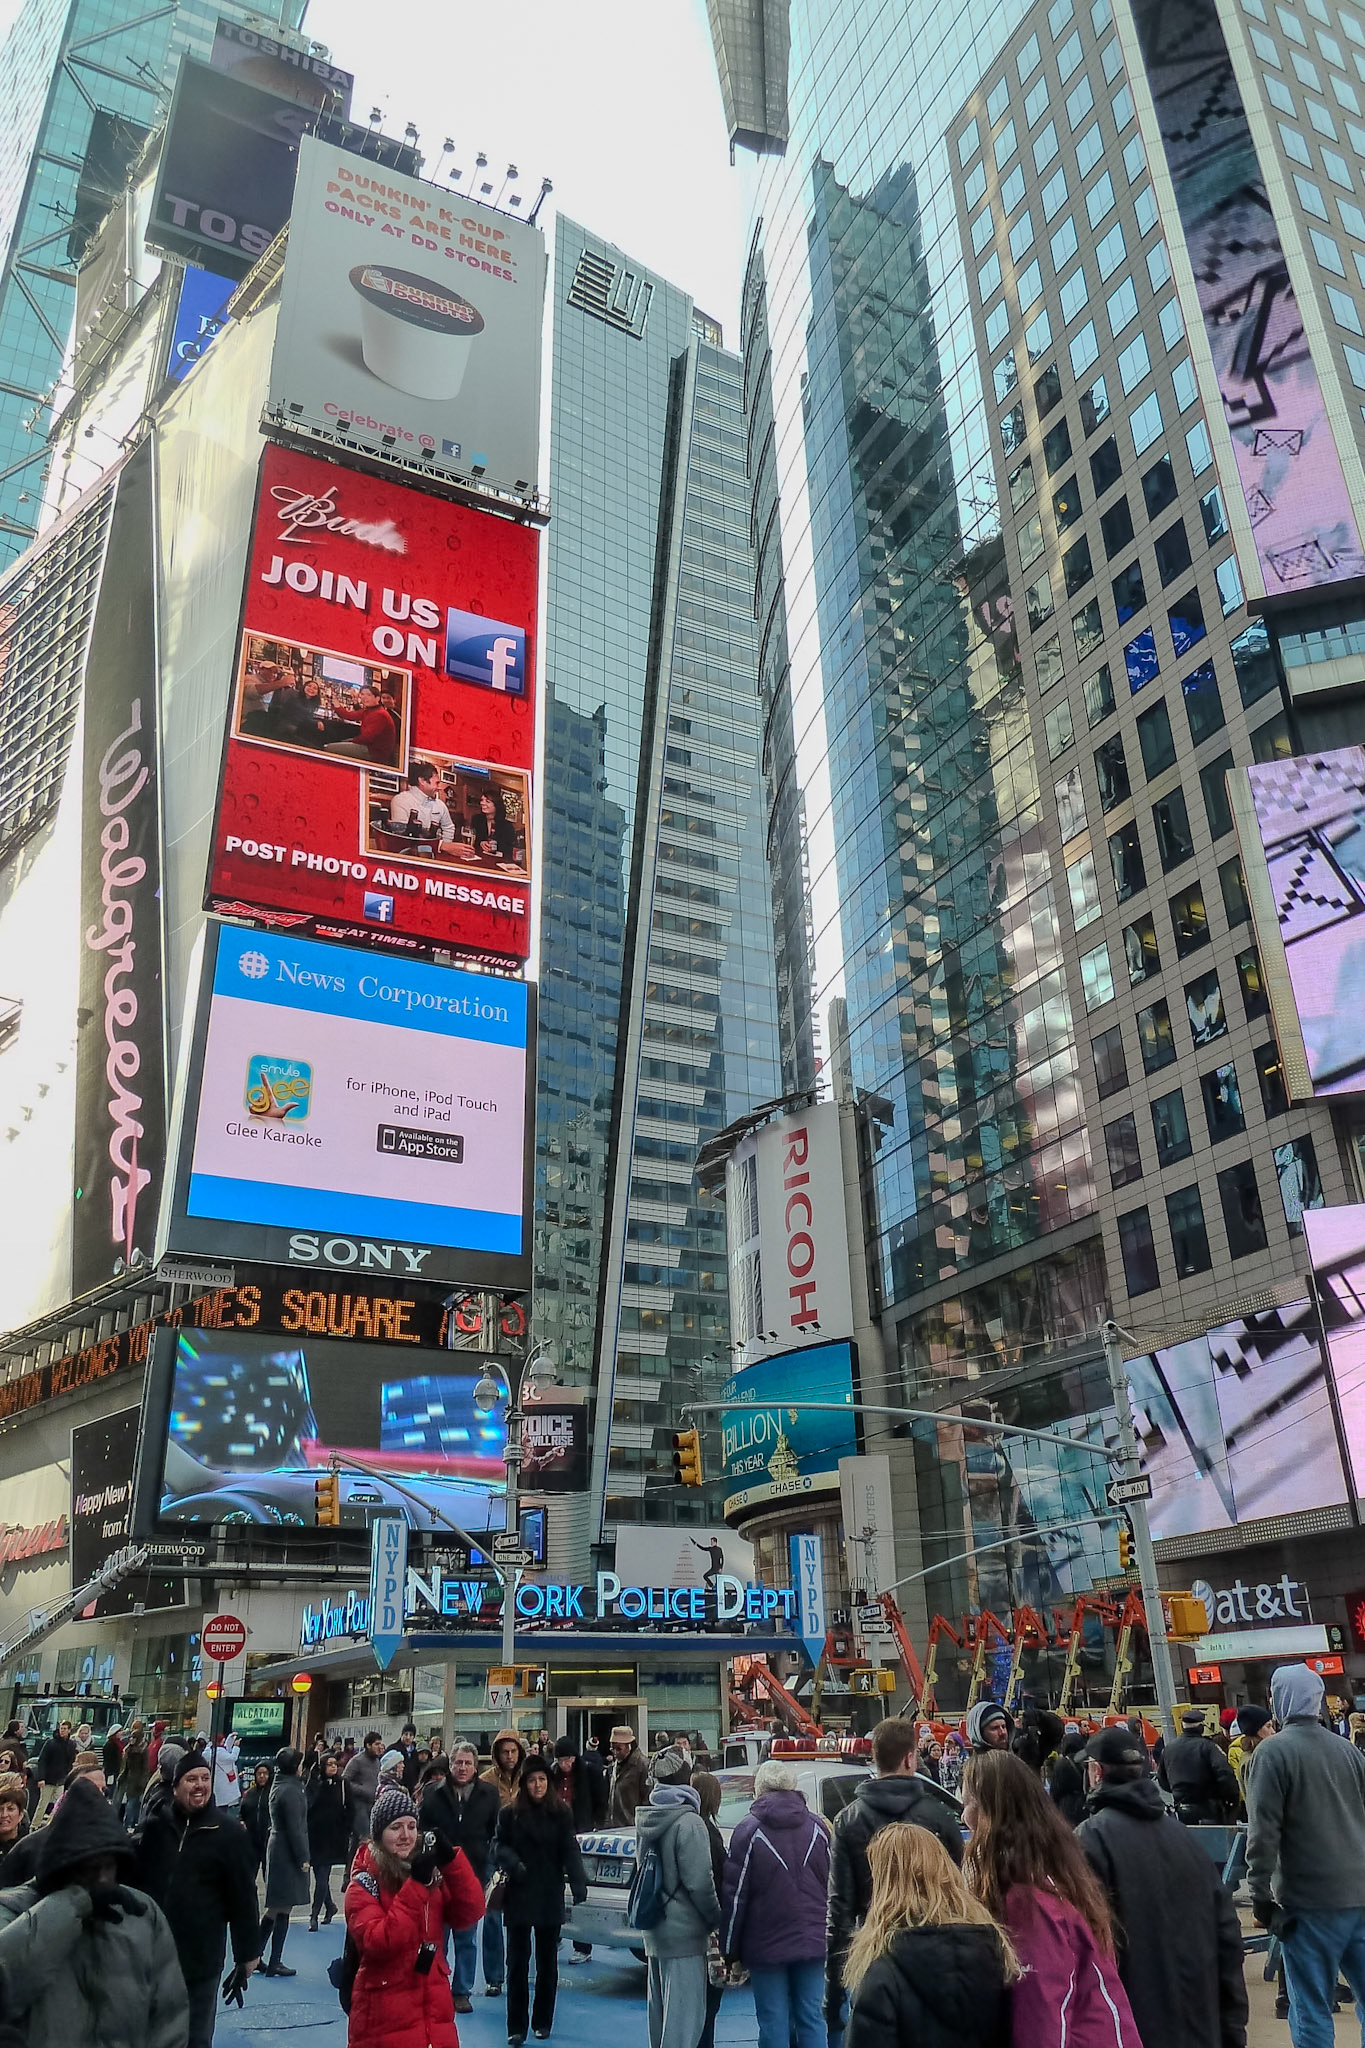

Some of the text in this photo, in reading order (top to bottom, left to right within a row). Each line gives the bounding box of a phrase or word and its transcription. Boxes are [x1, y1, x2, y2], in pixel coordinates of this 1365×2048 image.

[220, 20, 350, 88] TOSHIBA
[338, 167, 431, 212] DUNKIN'
[324, 201, 518, 283] ONLY AT DD STORES.
[326, 181, 517, 266] PACKS ARE HERE.
[393, 288, 473, 323] DONUTS
[324, 402, 414, 442] Celebrate
[418, 434, 435, 448] @
[261, 555, 440, 629] JOIN US
[372, 625, 437, 669] ON
[225, 835, 525, 915] POST PHOTO AND MESSAGE
[275, 959, 510, 1024] News Corporation
[260, 1063, 301, 1078] smule
[346, 1077, 498, 1113] for iPhone, iPod Touch
[393, 1103, 451, 1122] and iPad
[226, 1121, 323, 1148] Glee Karaoke
[398, 1130, 459, 1147] Available on the
[398, 1140, 459, 1159] App Store
[781, 1126, 819, 1326] RICOH
[288, 1233, 432, 1273] SONY
[160, 1267, 232, 1284] SHERWOOD
[50, 1335, 121, 1398] WELCOMES
[280, 1289, 421, 1344] SQUARE
[551, 1435, 574, 1446] RISE
[726, 1408, 782, 1457] BILLION
[731, 1453, 765, 1476] THIS YEAR
[75, 1491, 105, 1516] Happy
[104, 1484, 127, 1507] New
[728, 1494, 743, 1509] CHASE
[770, 1479, 802, 1495] CHASE
[1112, 1482, 1145, 1498] ONE WAY
[101, 1520, 122, 1539] from
[382, 1523, 400, 1630] NYPD
[407, 1565, 488, 1616] NEW
[596, 1570, 706, 1619] POLICE
[716, 1574, 794, 1621] DEPT
[804, 1539, 820, 1634] NYPD
[1216, 1574, 1303, 1625] at&t
[210, 1623, 239, 1632] DO NOT
[301, 1603, 321, 1645] NEW
[321, 1597, 345, 1640] YORK
[211, 1644, 236, 1653] ENTER
[599, 1864, 621, 1878] 1231
